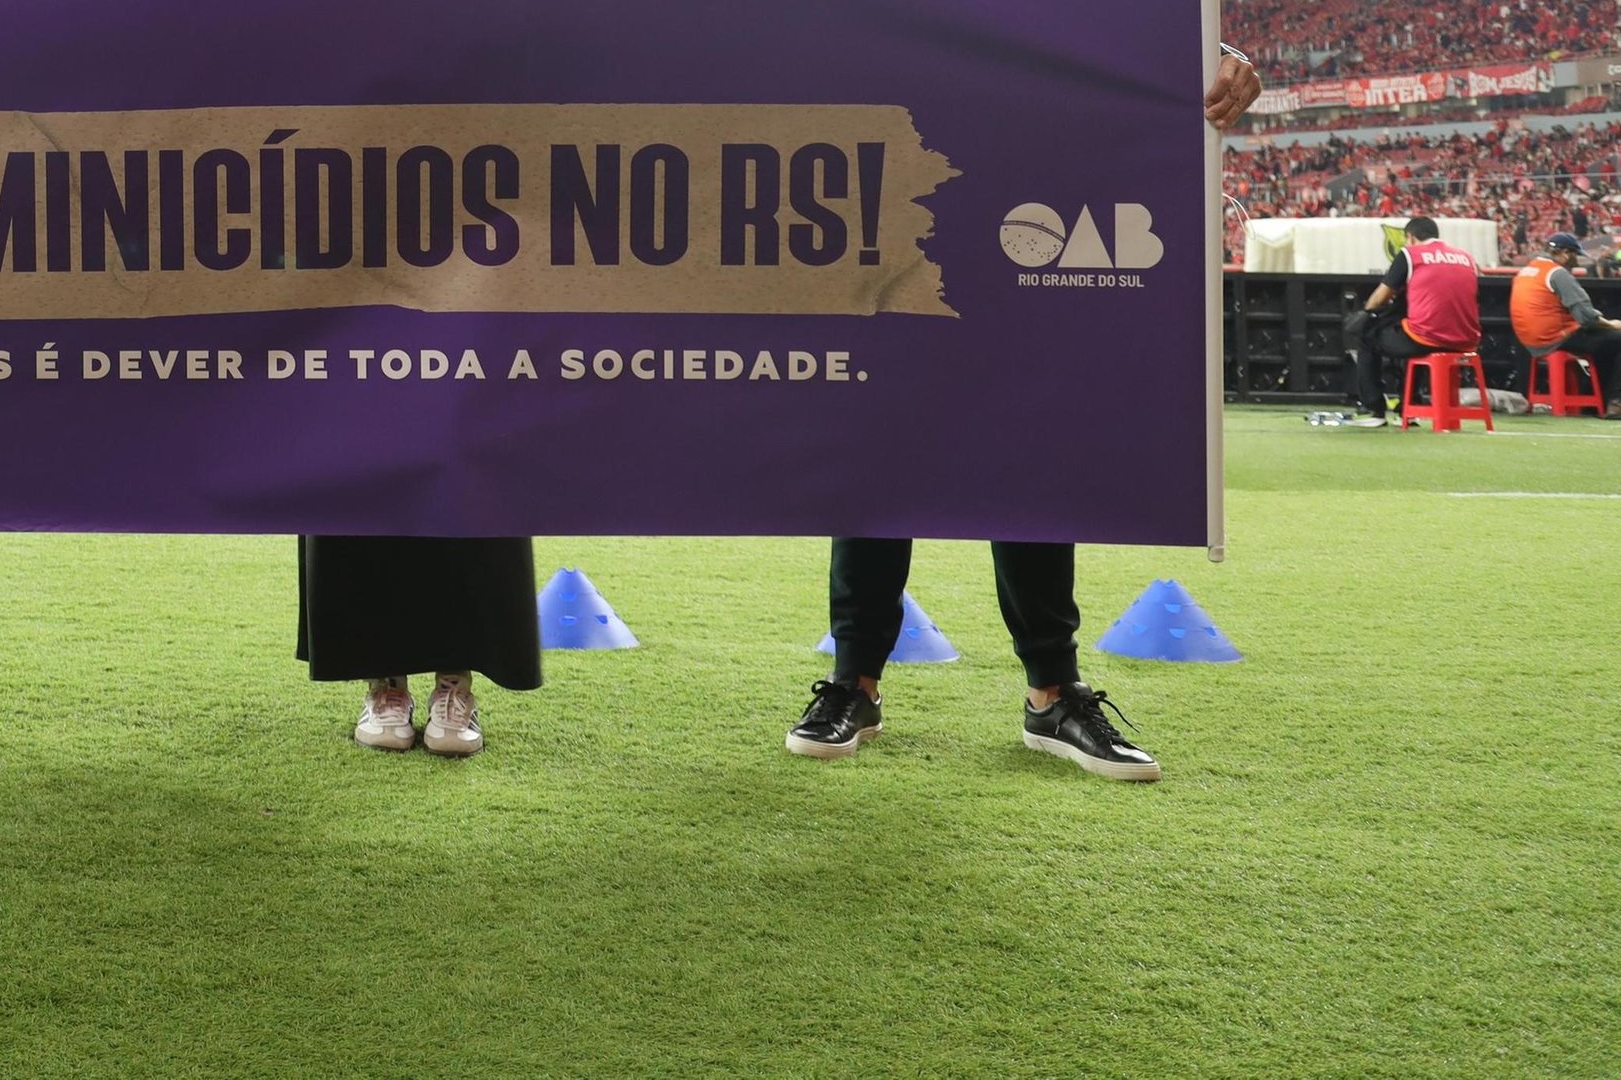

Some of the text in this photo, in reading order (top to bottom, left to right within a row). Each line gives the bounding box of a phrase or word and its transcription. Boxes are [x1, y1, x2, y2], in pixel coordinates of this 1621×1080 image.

[1365, 84, 1427, 105] INTER
[550, 143, 690, 266] NO
[721, 142, 885, 267] RS!
[999, 202, 1164, 269] OAB
[1420, 248, 1471, 267] RÁDIO
[1018, 274, 1145, 288] RIO GRANDE DO SUL
[35, 342, 60, 380] É
[83, 350, 244, 380] DEVER
[267, 350, 329, 379] DE
[349, 349, 486, 380] TODA
[507, 349, 539, 380] A
[560, 349, 869, 381] SOCIEDADE.
